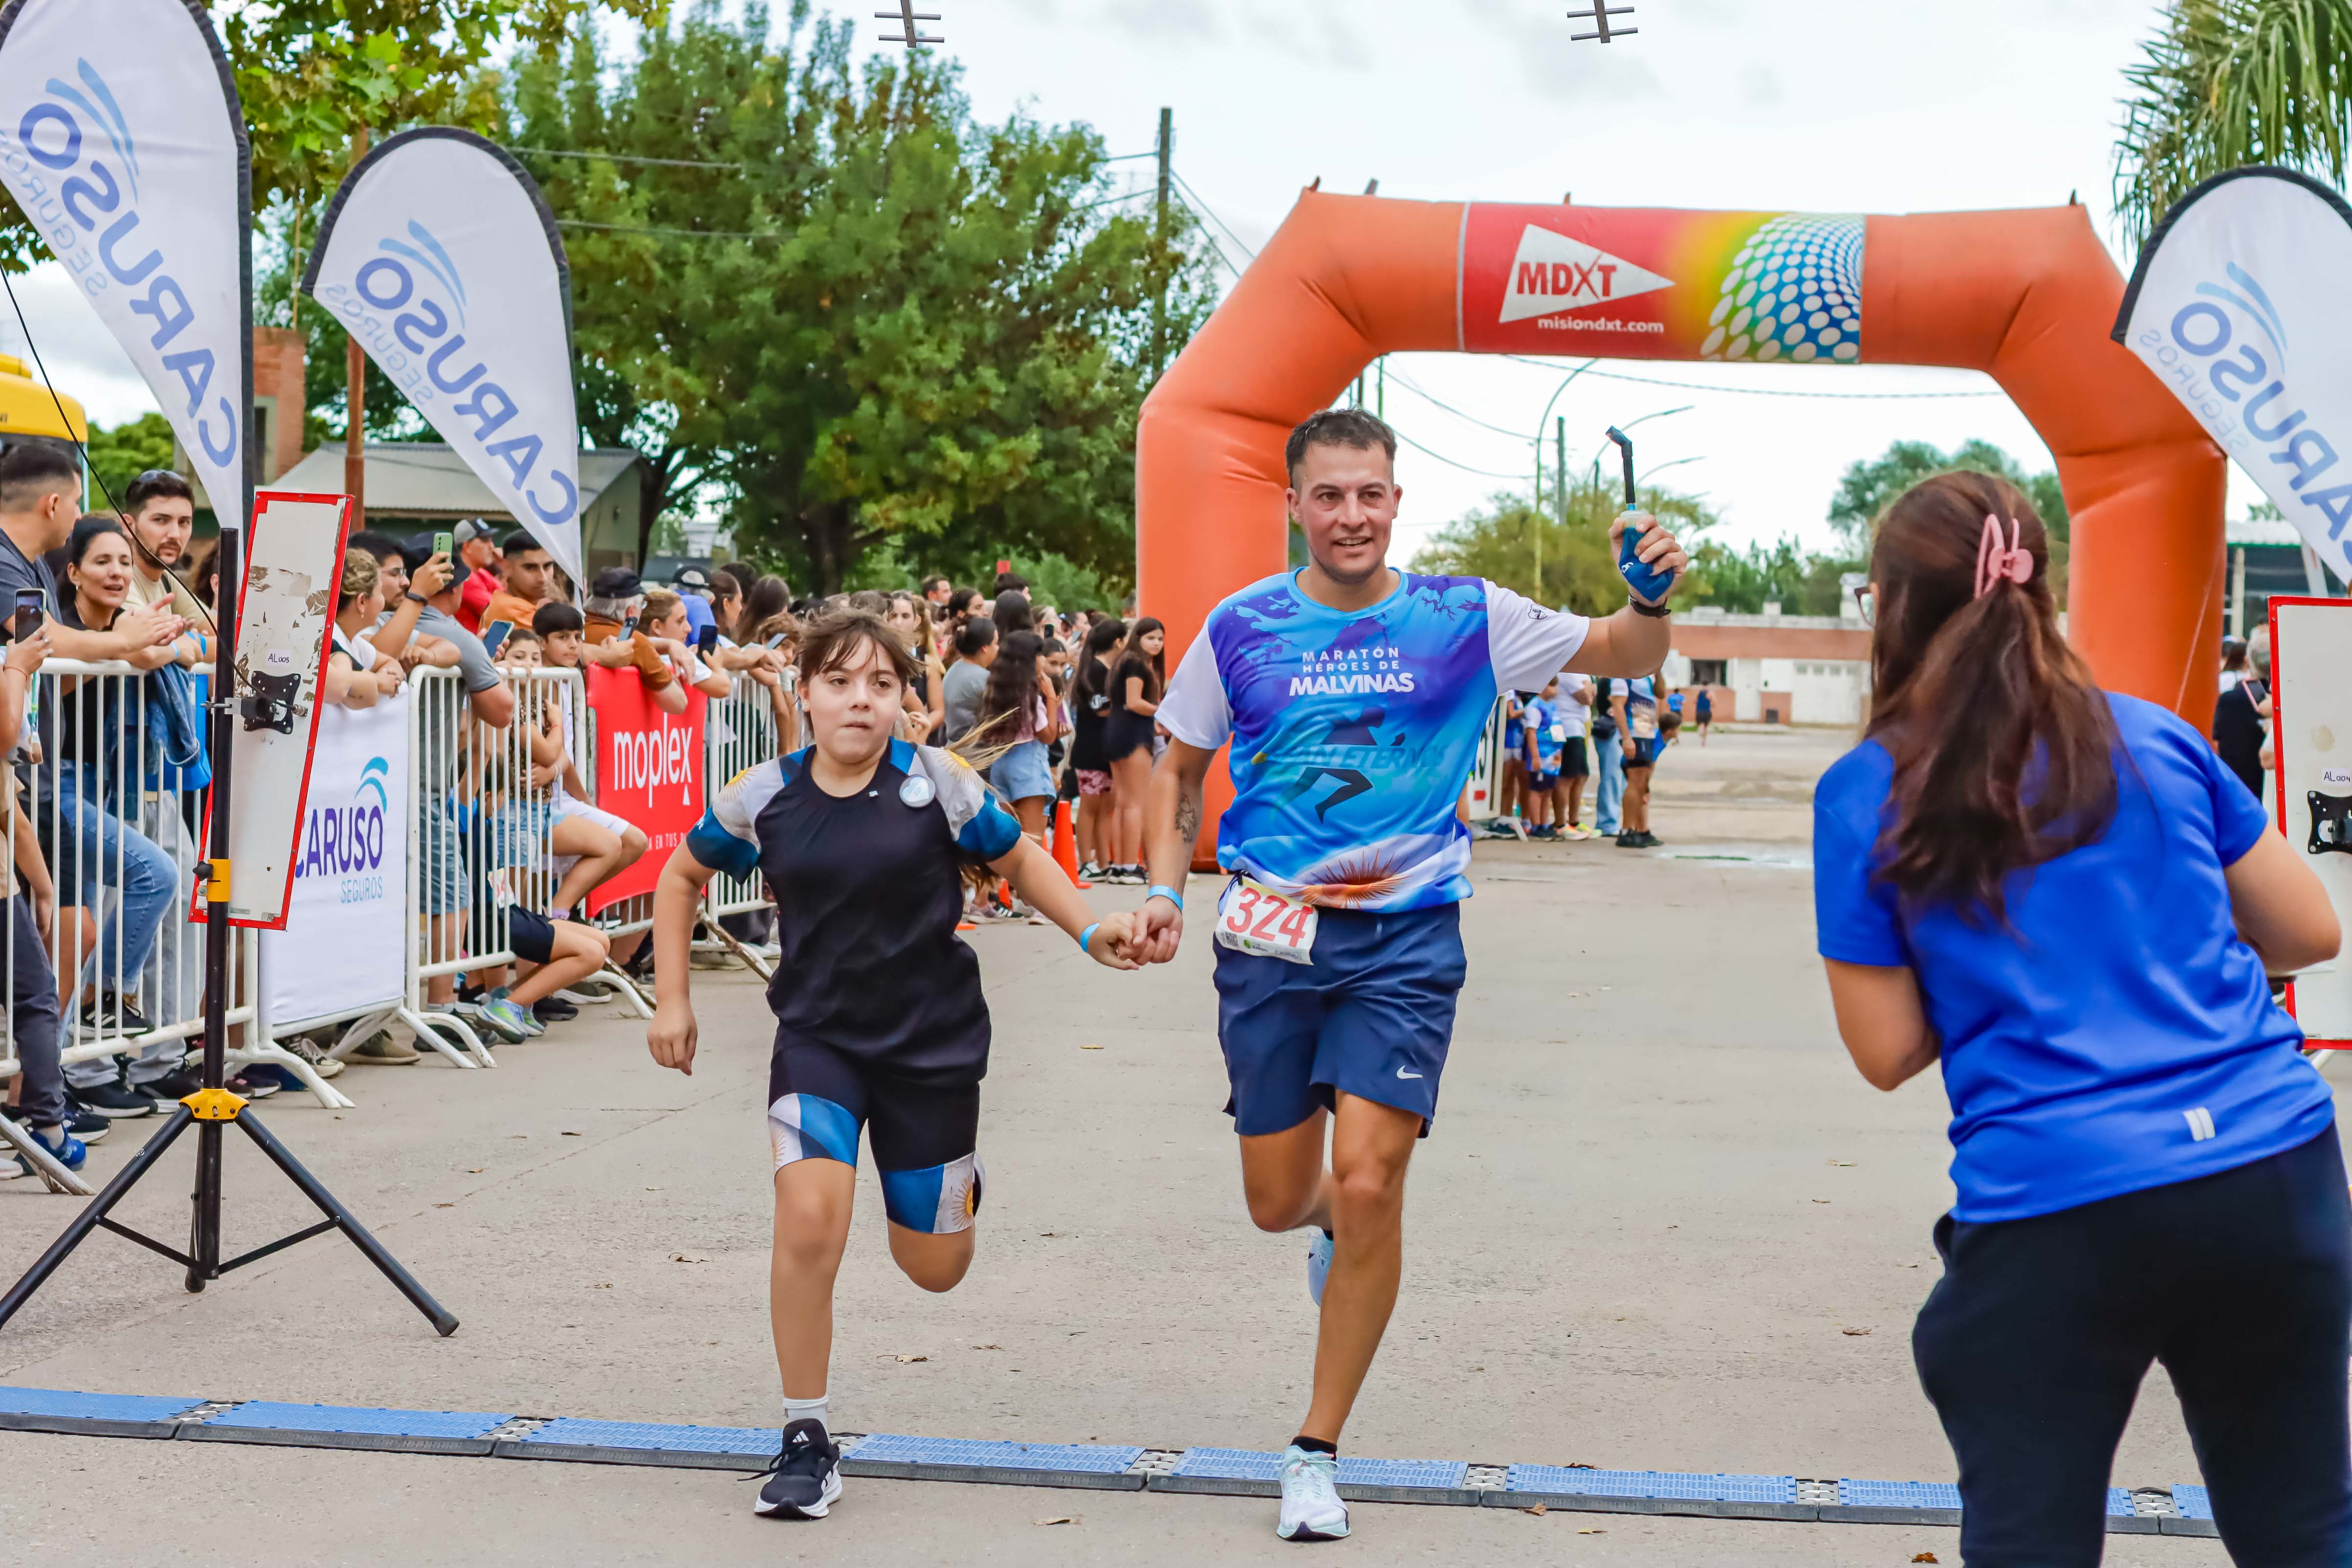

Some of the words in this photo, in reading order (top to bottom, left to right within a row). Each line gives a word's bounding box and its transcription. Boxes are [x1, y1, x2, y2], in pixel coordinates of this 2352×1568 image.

[1517, 252, 1617, 301] MDXT
[1538, 316, 1664, 333] misiondxt.com
[1302, 646, 1399, 663] MARATÓN
[1303, 662, 1370, 673] HÉROES
[1379, 661, 1399, 670] DE
[1289, 672, 1415, 696] MALVINAS
[613, 711, 693, 808] moplex
[655, 834, 663, 850] EN
[666, 833, 677, 847] TUS
[341, 876, 383, 903] SEGUROS
[1226, 887, 1313, 947] 324
